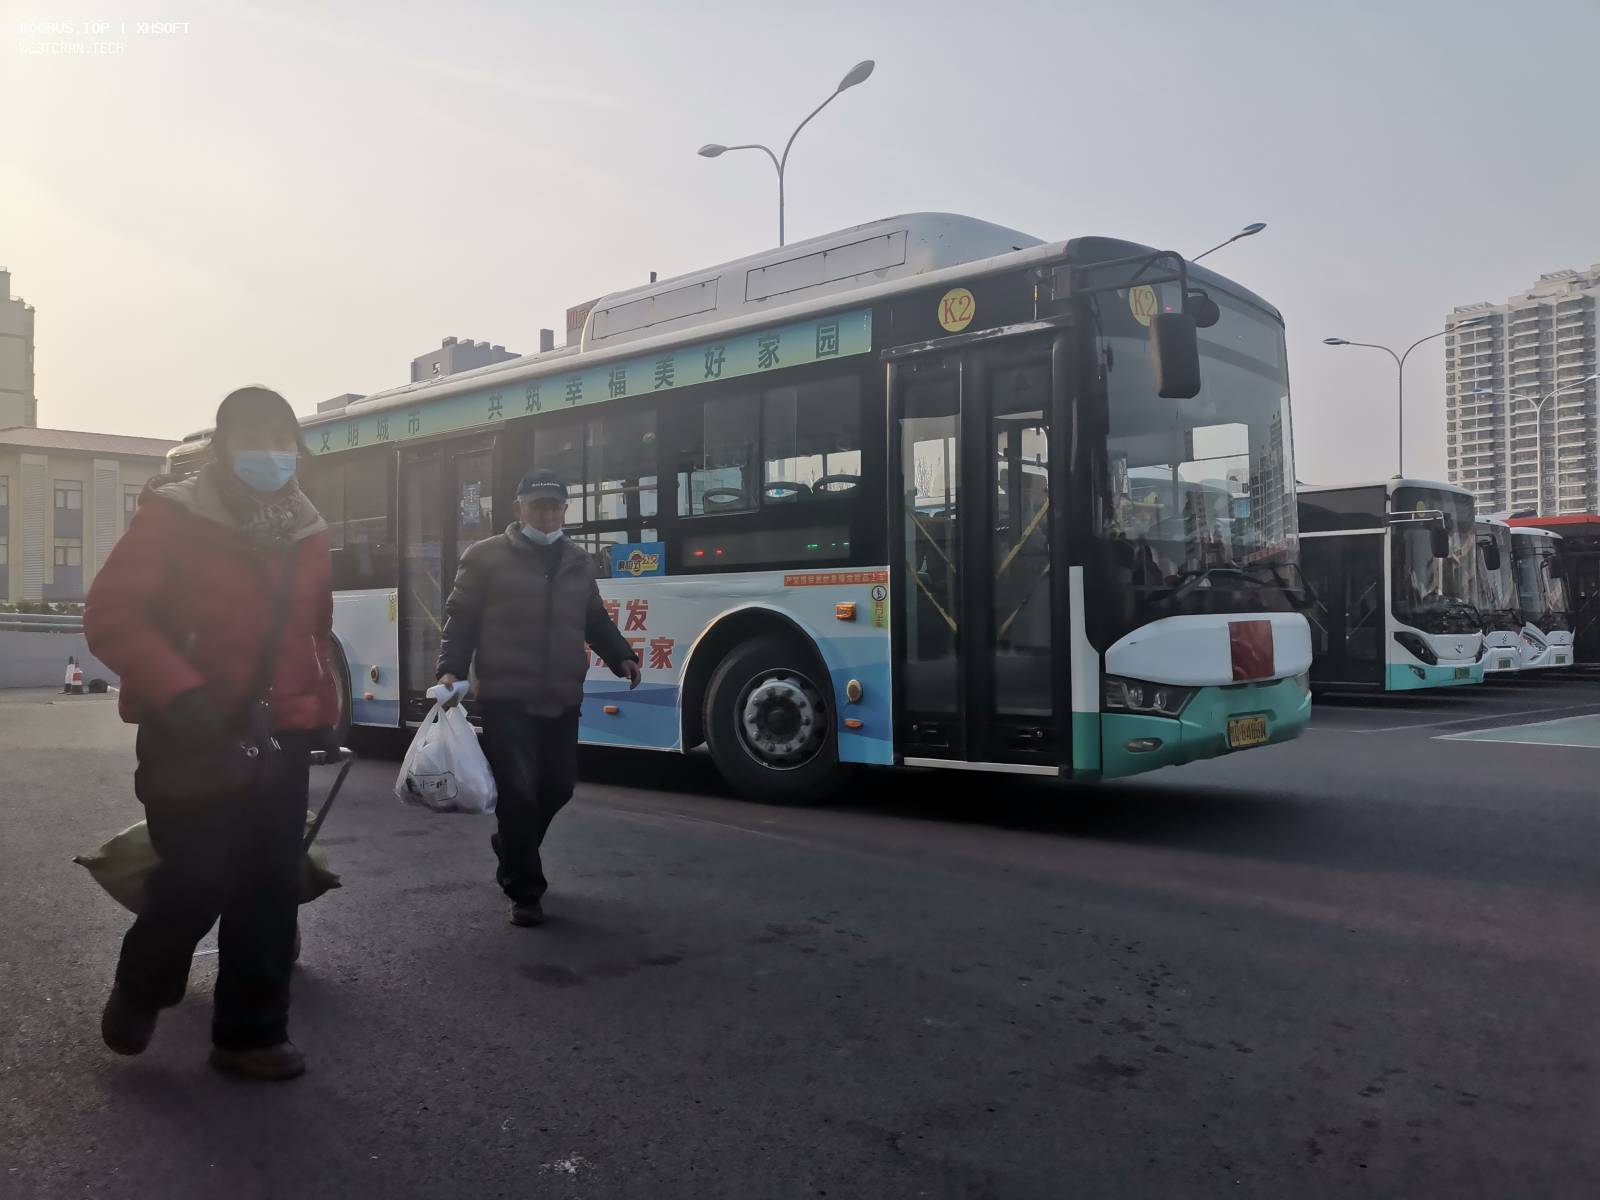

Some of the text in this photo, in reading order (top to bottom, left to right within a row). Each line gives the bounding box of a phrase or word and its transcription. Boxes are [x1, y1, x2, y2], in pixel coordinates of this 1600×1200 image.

[942, 294, 972, 325] K2
[1132, 286, 1156, 317] K2
[320, 322, 840, 453] 文明城市 共筑幸福美好家园
